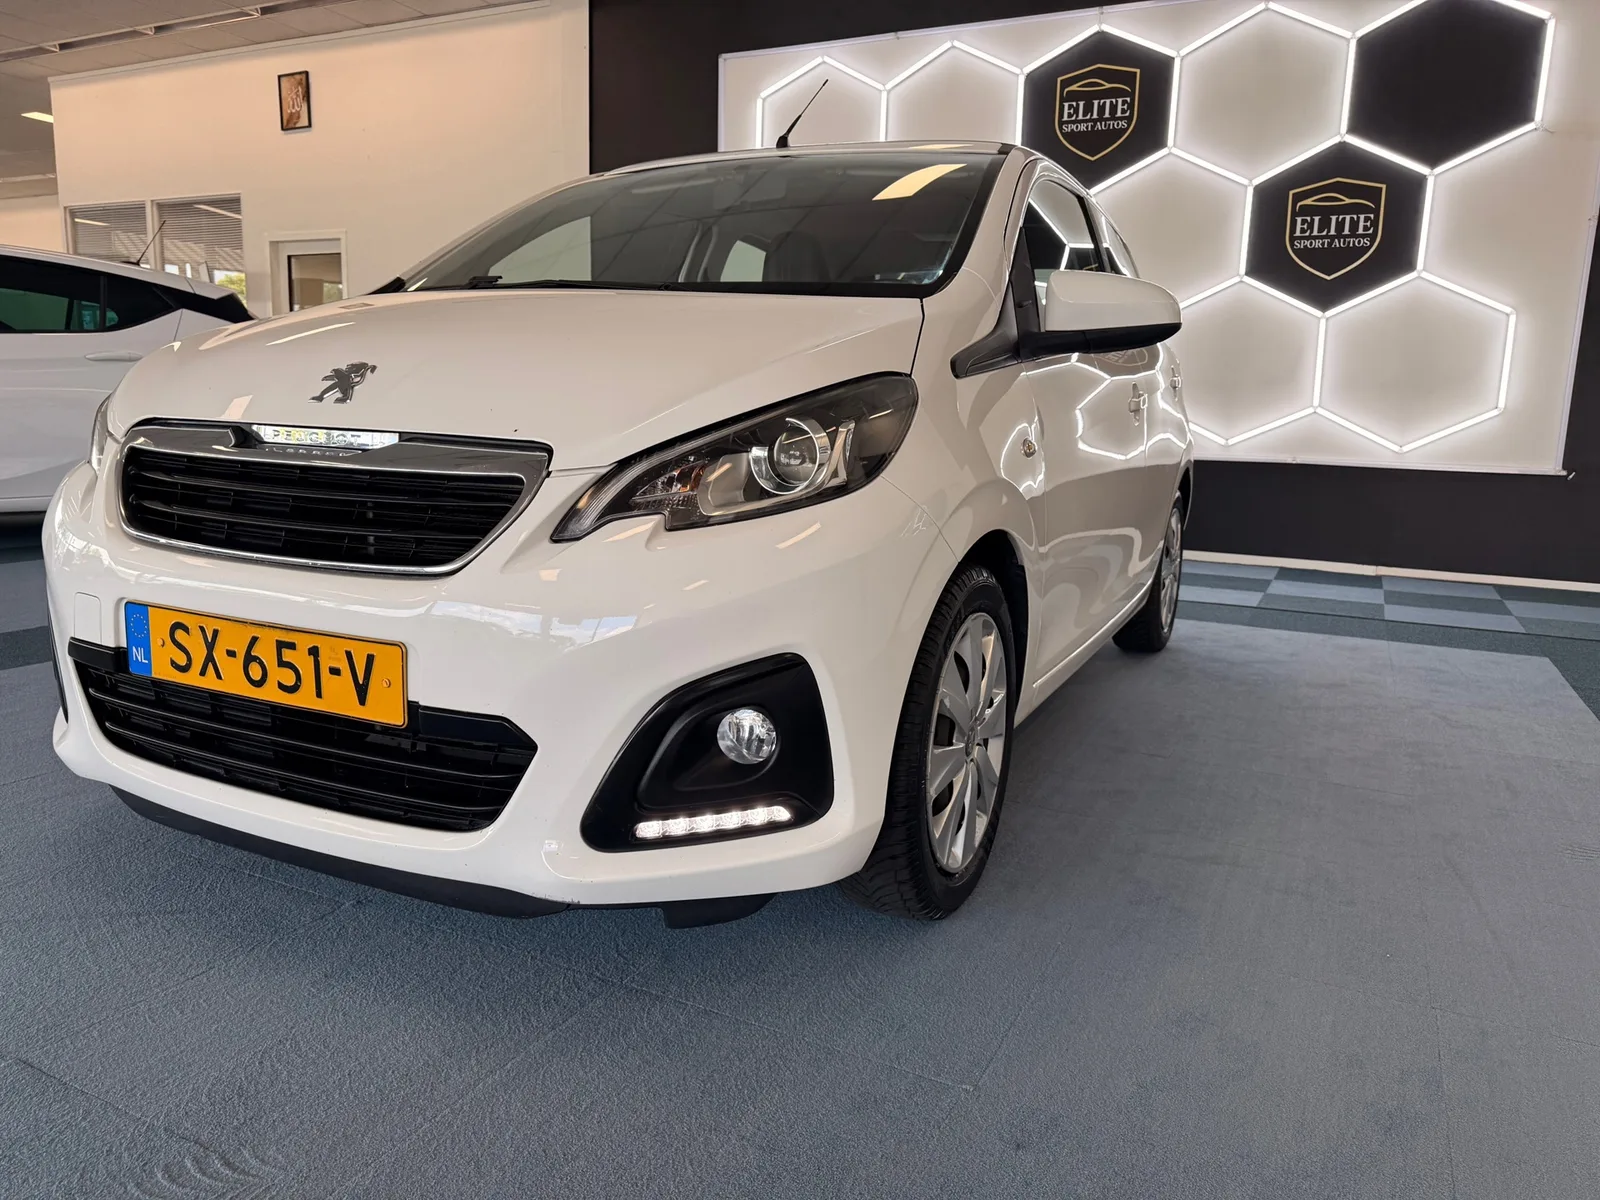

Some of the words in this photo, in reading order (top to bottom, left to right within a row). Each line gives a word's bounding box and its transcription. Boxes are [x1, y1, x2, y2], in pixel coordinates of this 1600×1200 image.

[1061, 97, 1131, 121] ELITE
[1062, 121, 1094, 133] SPORT
[1094, 119, 1128, 131] AUTOS
[1293, 213, 1374, 237] ELITE
[1293, 238, 1330, 249] SPORT
[1332, 237, 1371, 248] AUTOS
[132, 645, 149, 664] NL
[169, 621, 375, 707] SX-651-V
